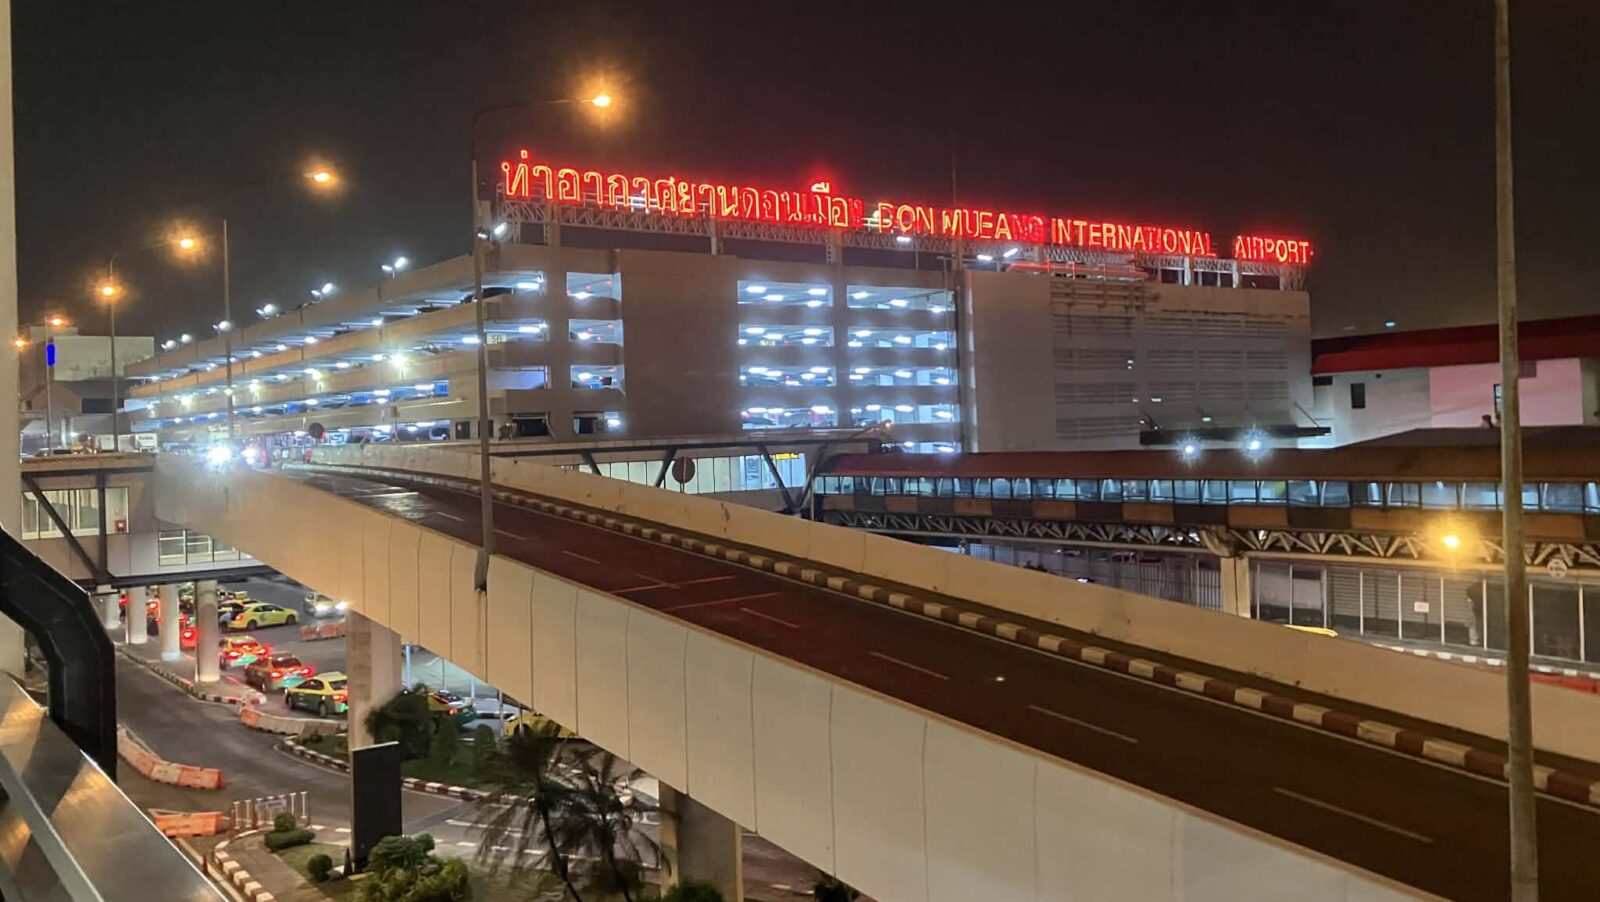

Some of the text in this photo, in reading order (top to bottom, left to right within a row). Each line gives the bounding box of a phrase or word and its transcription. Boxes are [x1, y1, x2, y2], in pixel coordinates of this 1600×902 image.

[878, 202, 1310, 263] DON MUEANG INTERNATIONAL AIRPORT
